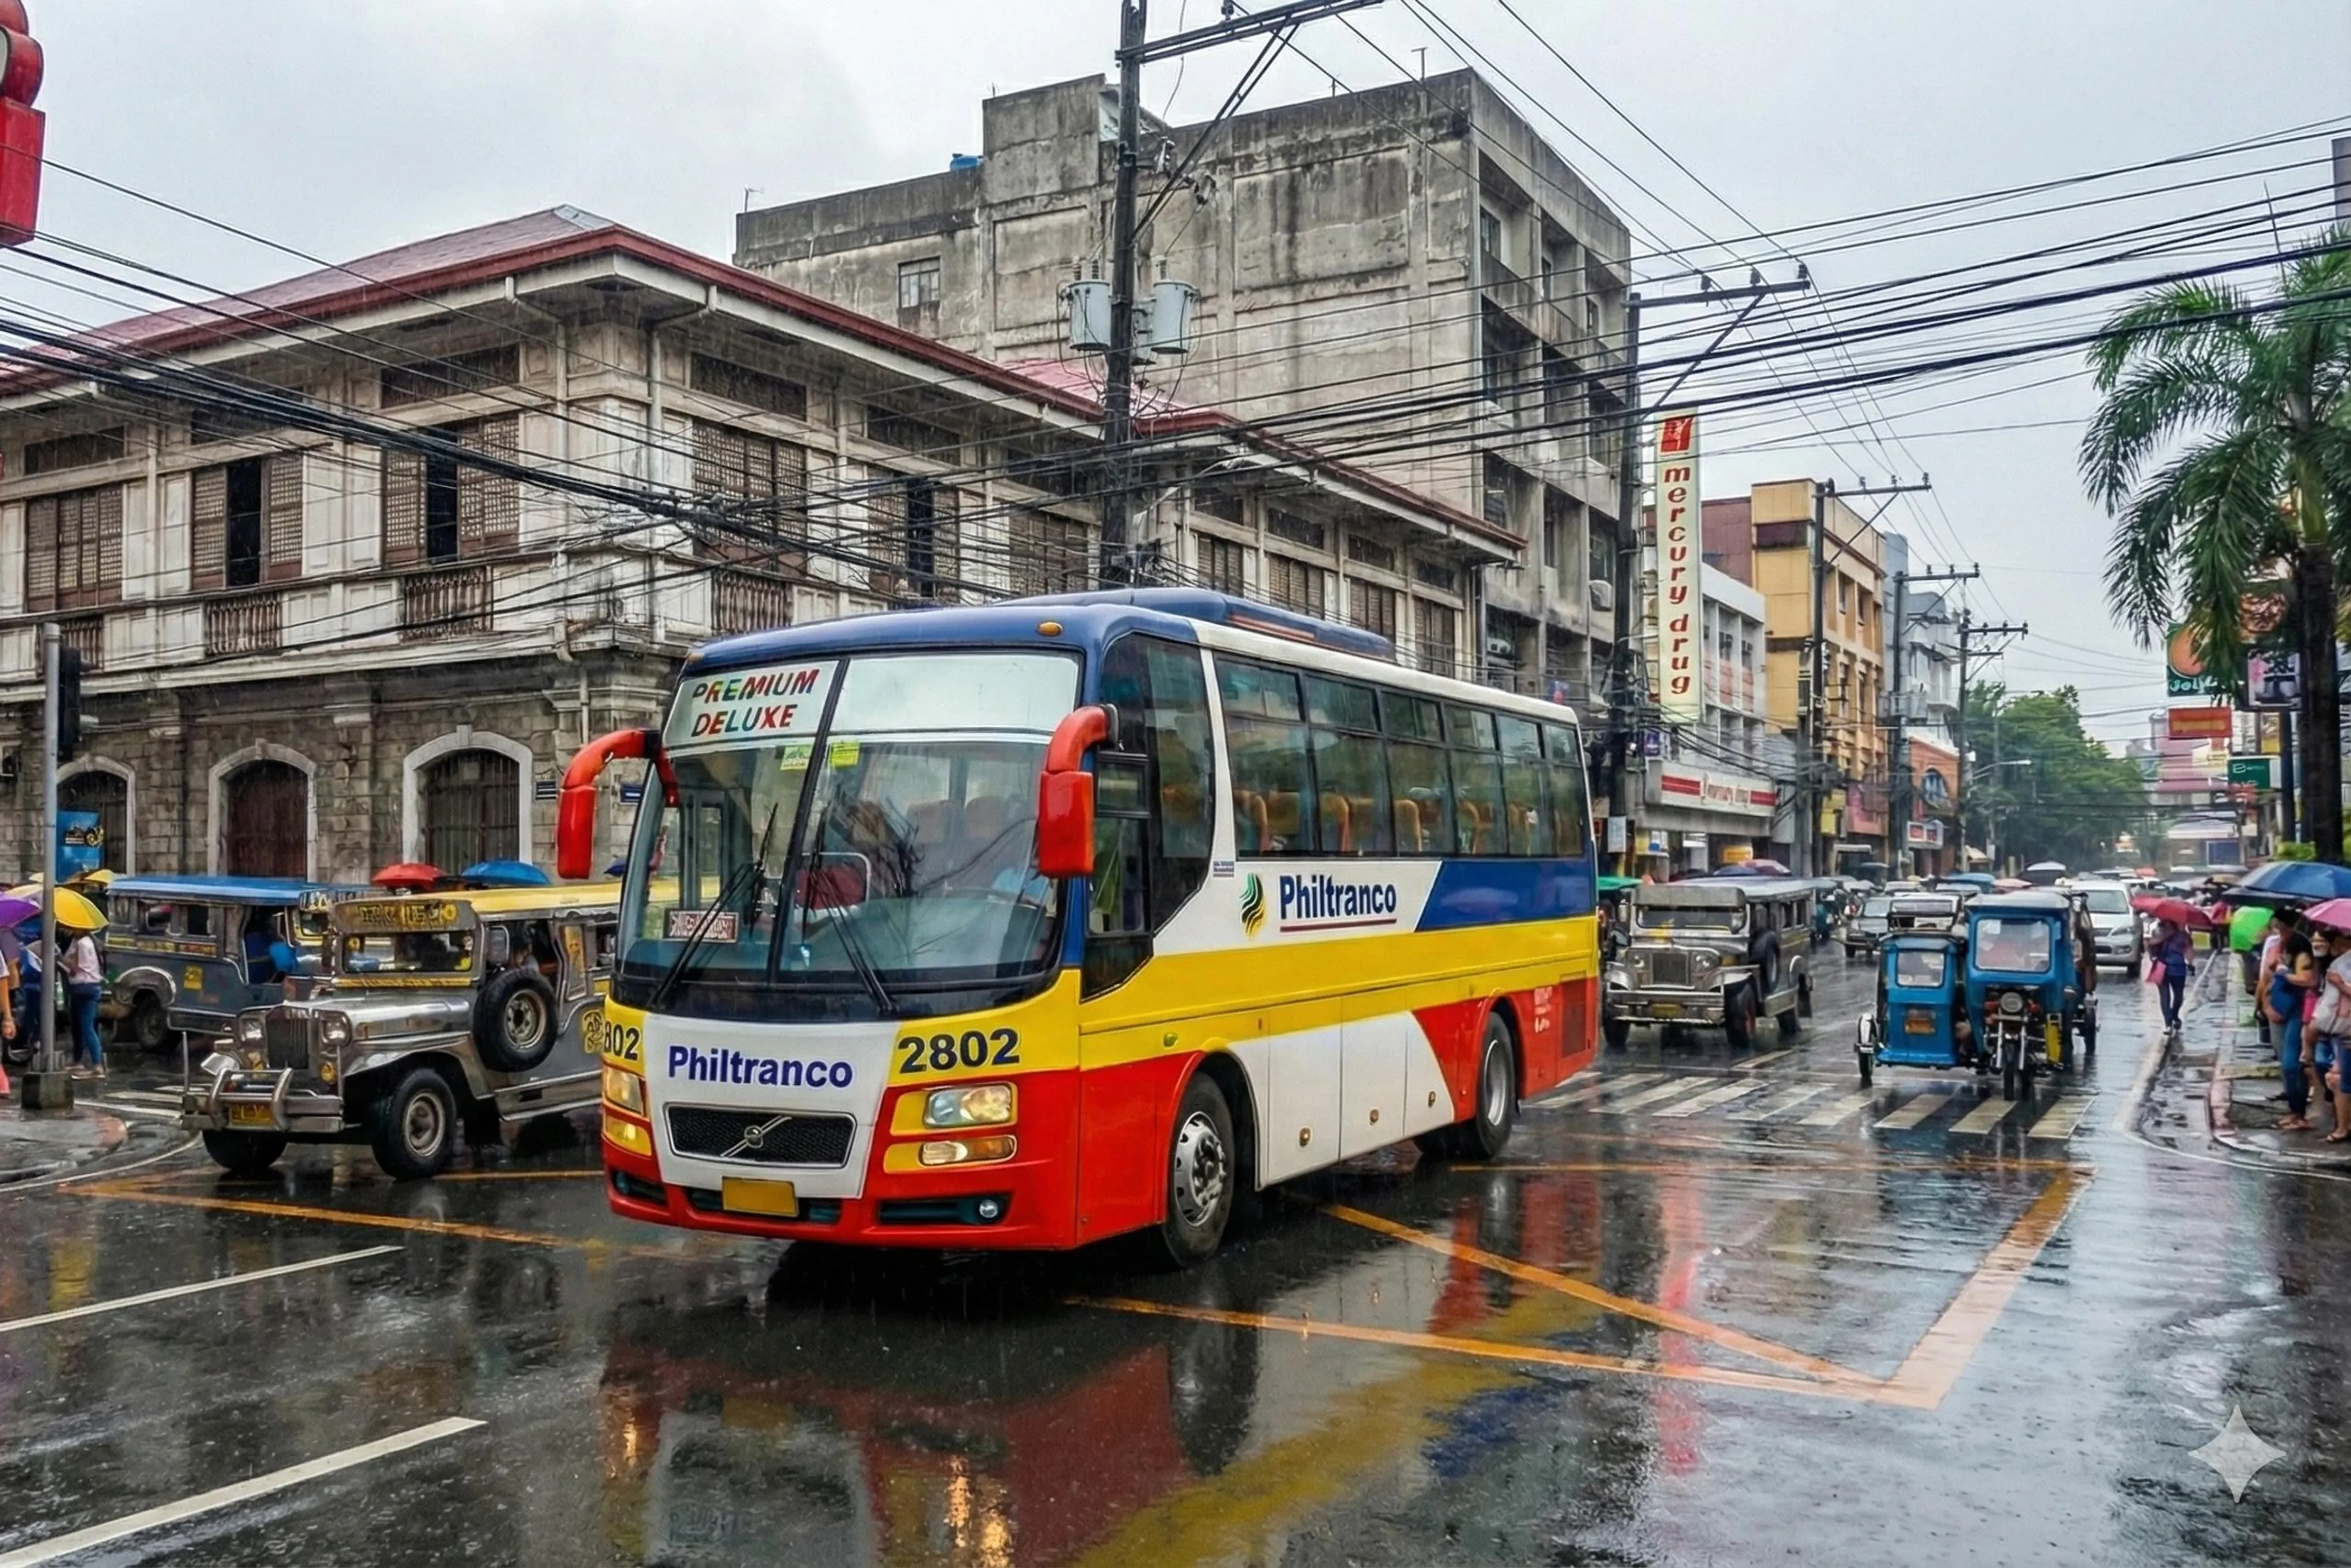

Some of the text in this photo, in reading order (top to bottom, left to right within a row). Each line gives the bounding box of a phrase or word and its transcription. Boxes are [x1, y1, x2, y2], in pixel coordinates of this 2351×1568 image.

[1663, 466, 1690, 695] mercury drug
[692, 669, 820, 703] PREMIUM
[691, 704, 798, 738] DELUXE
[1280, 874, 1397, 920] Philtranco
[669, 1045, 853, 1089] Philtranco
[898, 1028, 1021, 1074] 2802
